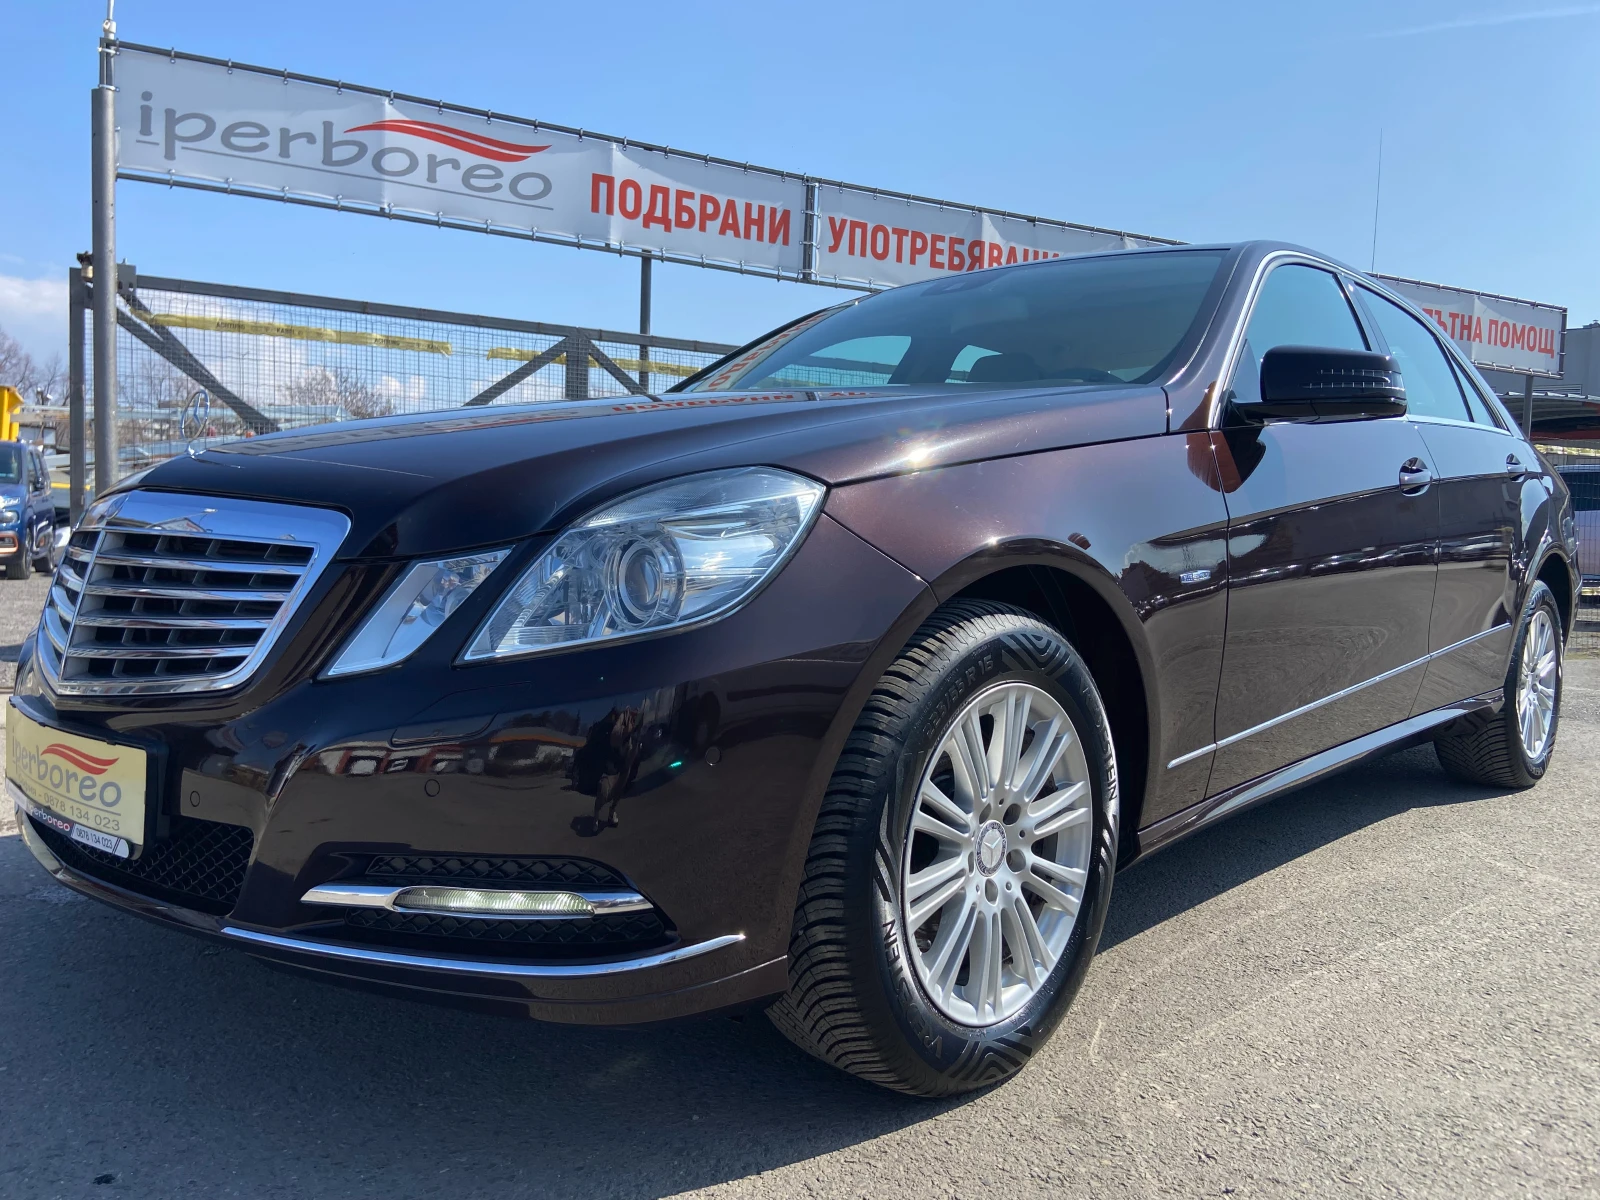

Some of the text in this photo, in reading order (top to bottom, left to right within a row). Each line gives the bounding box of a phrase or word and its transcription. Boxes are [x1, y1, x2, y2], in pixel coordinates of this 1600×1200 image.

[138, 91, 553, 201] iperboreo
[591, 173, 1060, 272] ПОДБРАНИ УПОТРЕБЯВА
[1488, 318, 1555, 359] ПОМОЩ
[965, 666, 976, 685] R
[978, 654, 994, 675] 16
[12, 725, 122, 807] iperboreo
[44, 792, 66, 812] 0878
[70, 805, 90, 822] 134
[94, 815, 120, 831] 023
[76, 827, 90, 841] 0878
[90, 832, 101, 846] 134
[101, 836, 113, 850] 023
